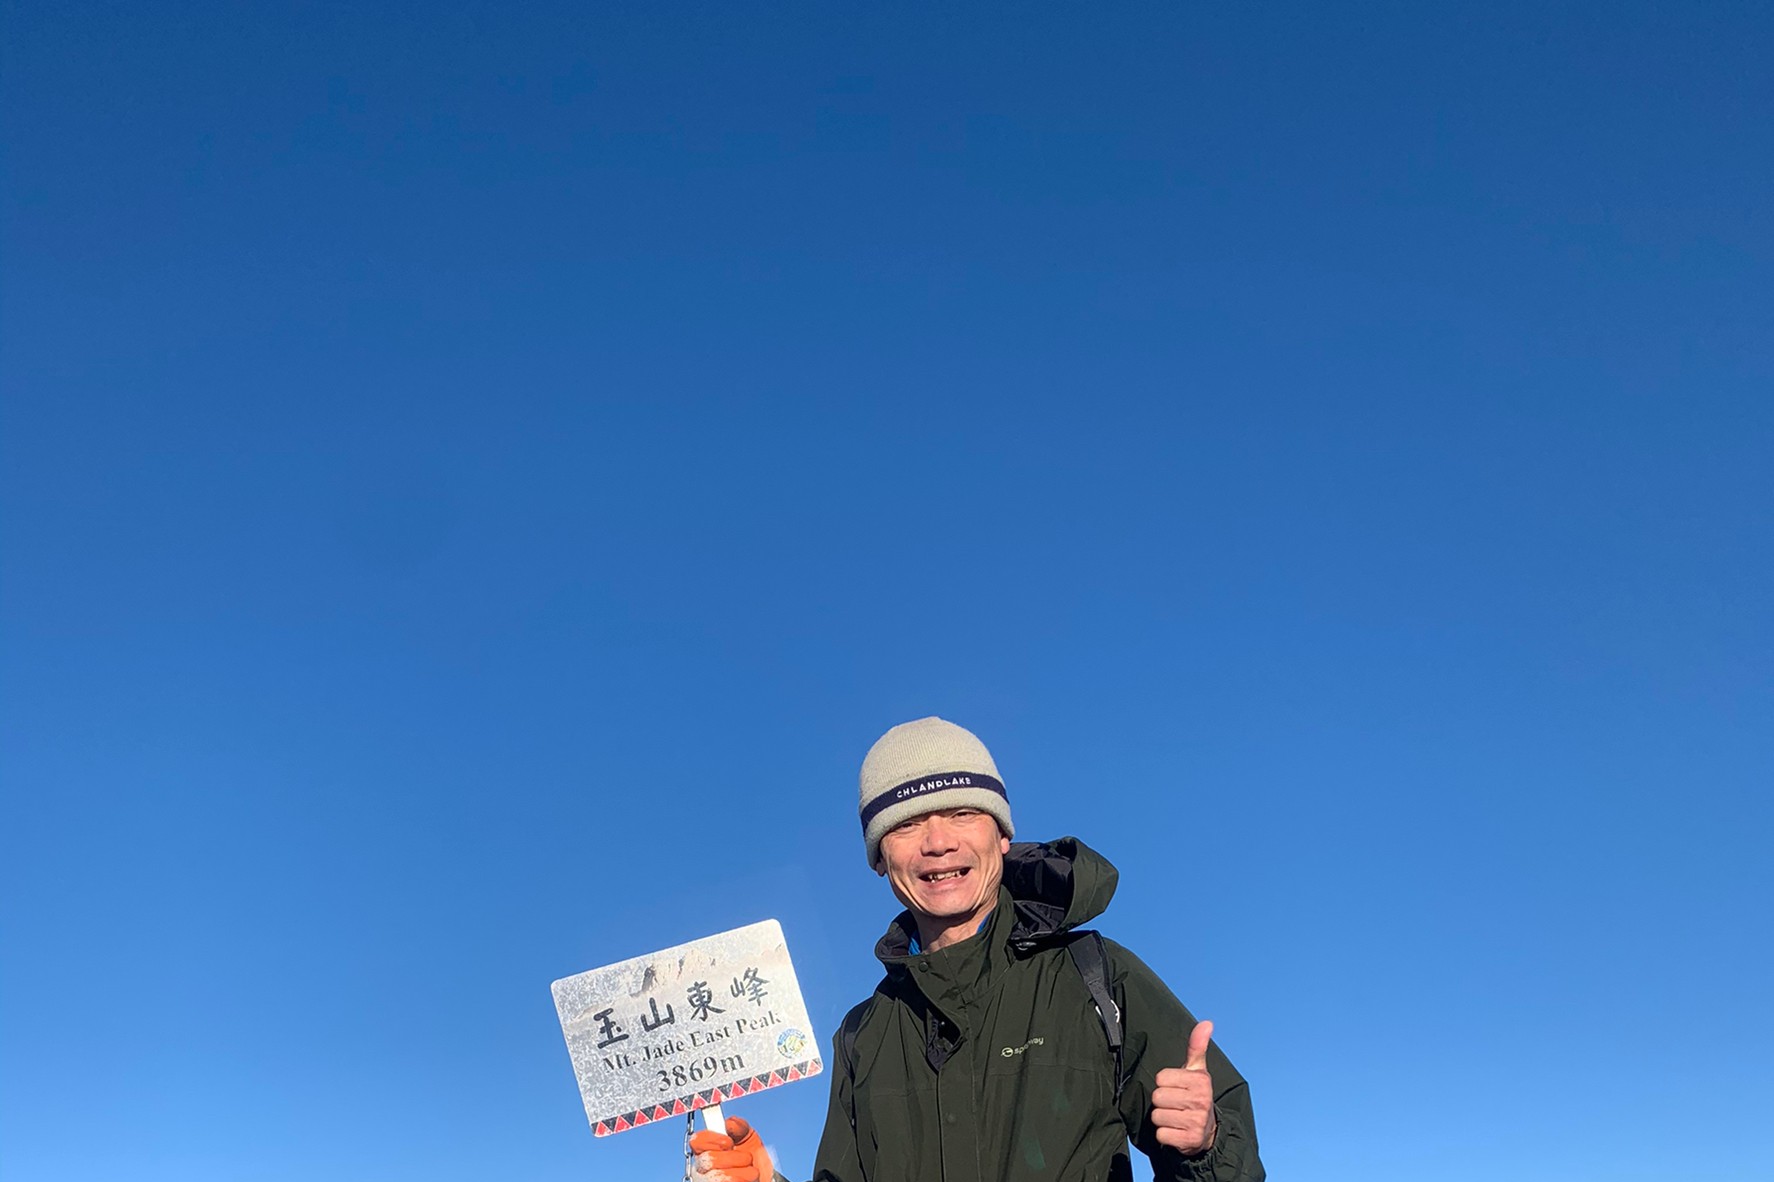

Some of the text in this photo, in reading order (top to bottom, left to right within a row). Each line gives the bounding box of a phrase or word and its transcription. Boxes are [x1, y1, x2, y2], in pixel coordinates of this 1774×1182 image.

[896, 776, 972, 798] CHLANDLAKE
[593, 966, 770, 1049] 玉山東峰
[602, 1010, 781, 1073] Mt. Jade East Peak
[655, 1053, 746, 1092] 3869m
